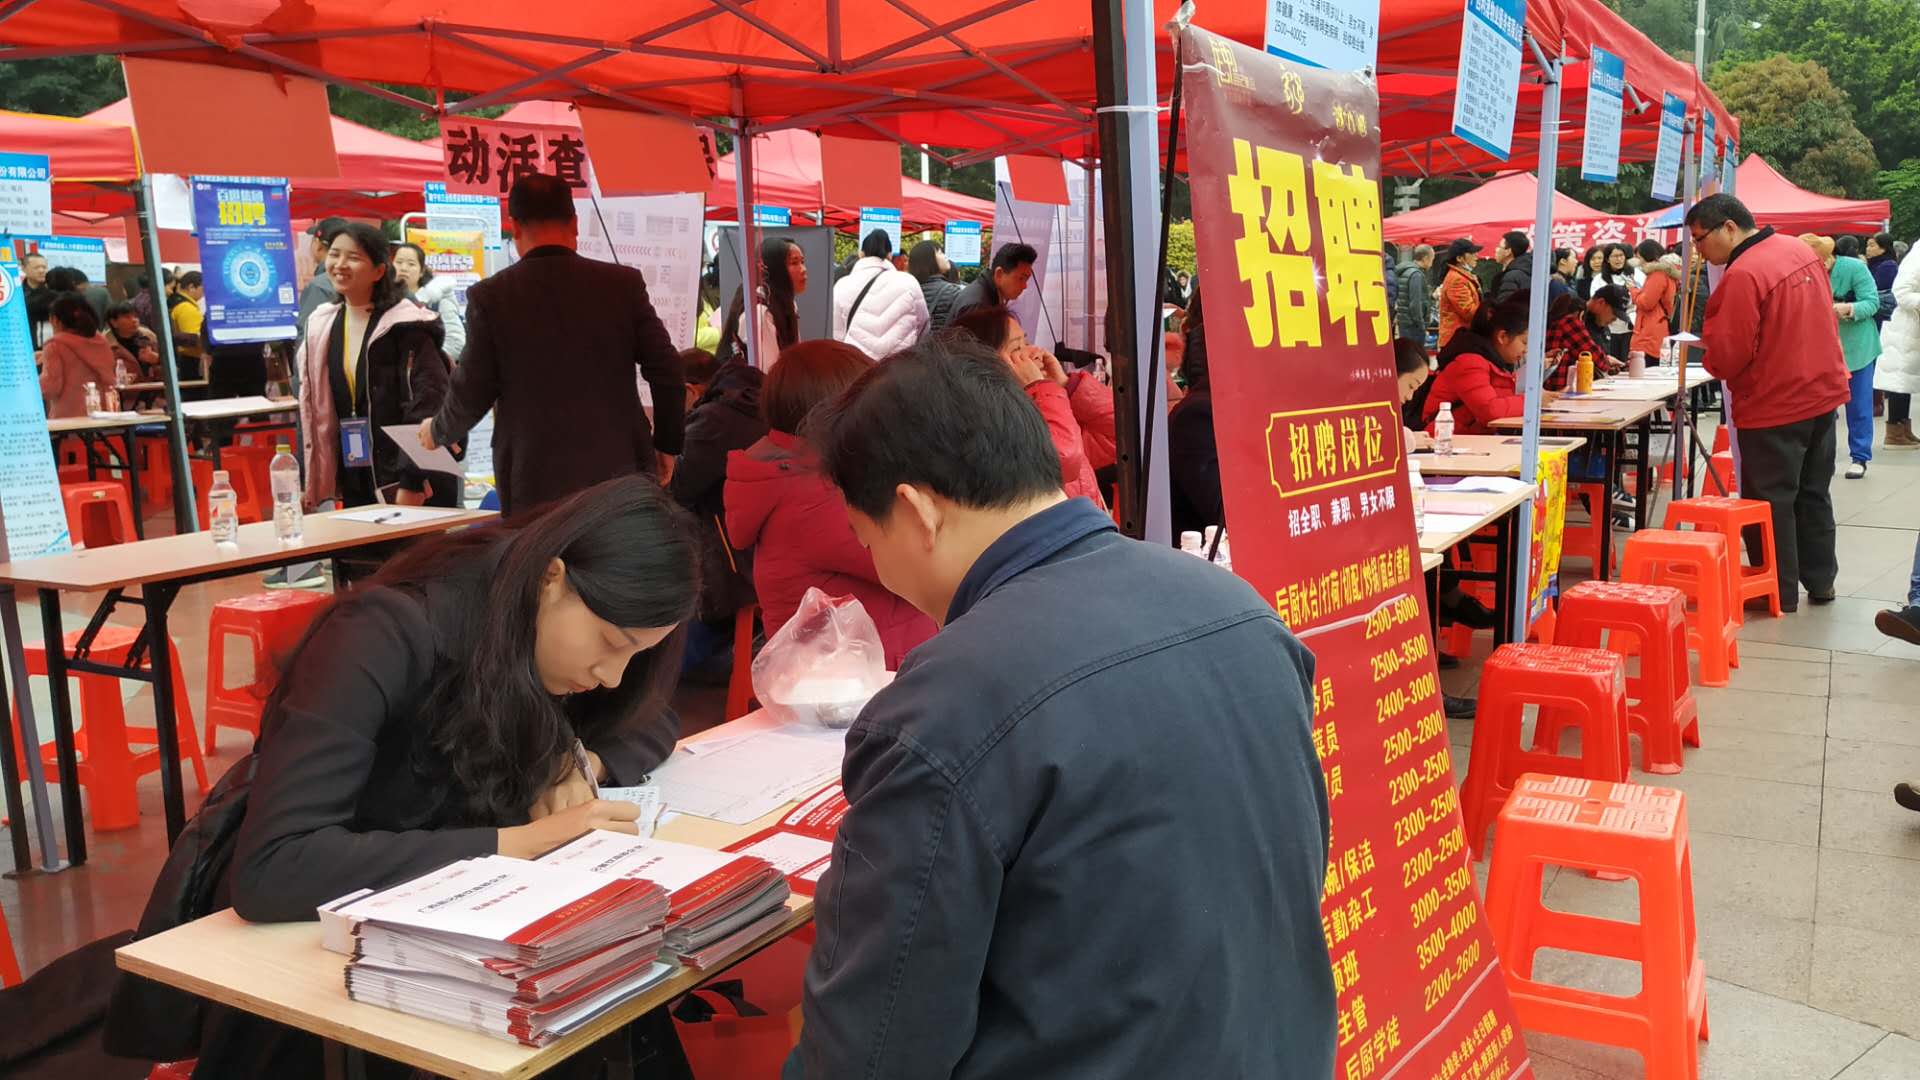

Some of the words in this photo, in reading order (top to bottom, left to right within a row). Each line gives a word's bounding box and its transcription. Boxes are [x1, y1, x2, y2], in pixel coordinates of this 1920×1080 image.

[218, 201, 267, 226] 招聘
[1228, 138, 1390, 348] 招聘
[1288, 415, 1384, 482] 招聘岗位
[1288, 485, 1396, 538] 招全职、兼职、男女不限
[1364, 594, 1420, 640] 2500-6000
[1370, 634, 1428, 683] 2500-3500
[1376, 672, 1436, 724] 2400-3000
[1383, 710, 1443, 765] 2500-2800
[1389, 748, 1450, 806] 2300-2500
[1394, 785, 1457, 848] 2300-2500
[1321, 838, 1376, 903] 碗/保洁
[1402, 824, 1464, 889] 2300-2500
[1410, 863, 1471, 929] 3000-3500
[1416, 900, 1477, 970] 3500-4000
[1424, 938, 1480, 1012] 2200-2600
[1338, 994, 1369, 1048] 主管
